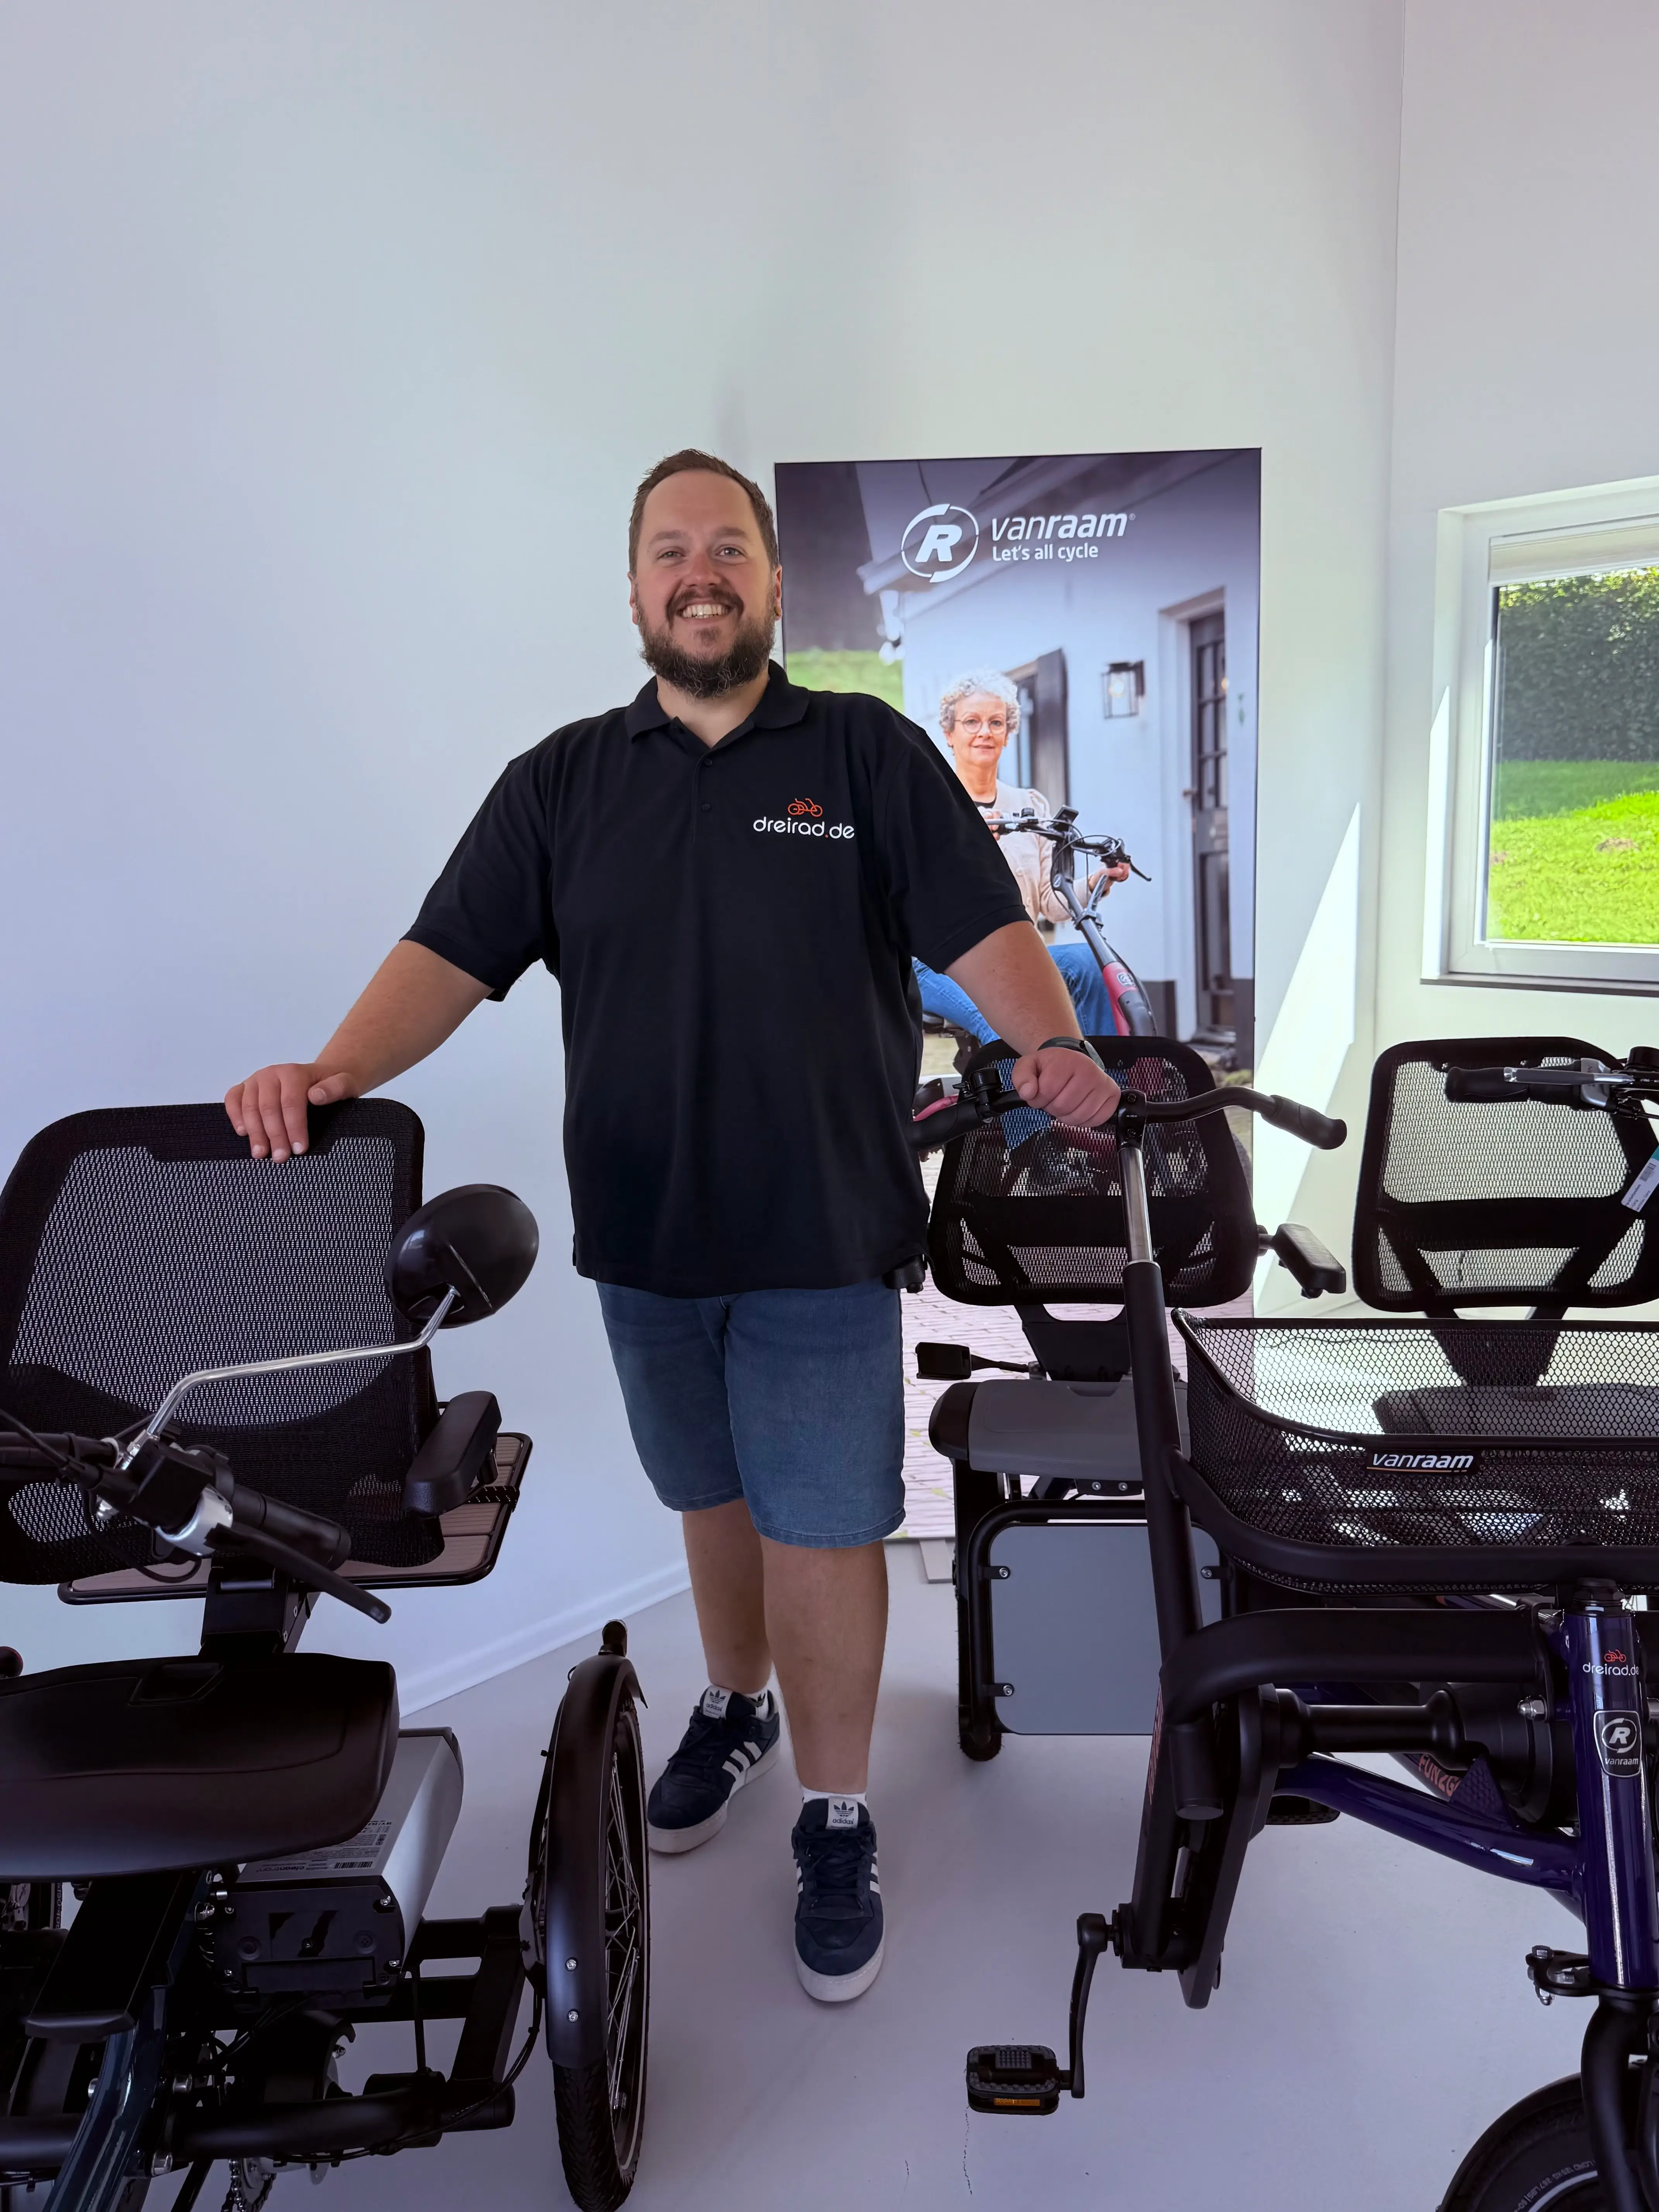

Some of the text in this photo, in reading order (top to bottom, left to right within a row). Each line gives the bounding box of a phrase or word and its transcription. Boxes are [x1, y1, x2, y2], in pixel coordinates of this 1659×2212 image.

[993, 543, 1099, 562] Let's all cycle
[753, 816, 855, 839] dreirad.de
[1372, 1453, 1474, 1468] vanraam
[1582, 1662, 1639, 1676] dreirad.de
[706, 1703, 723, 1712] adidas
